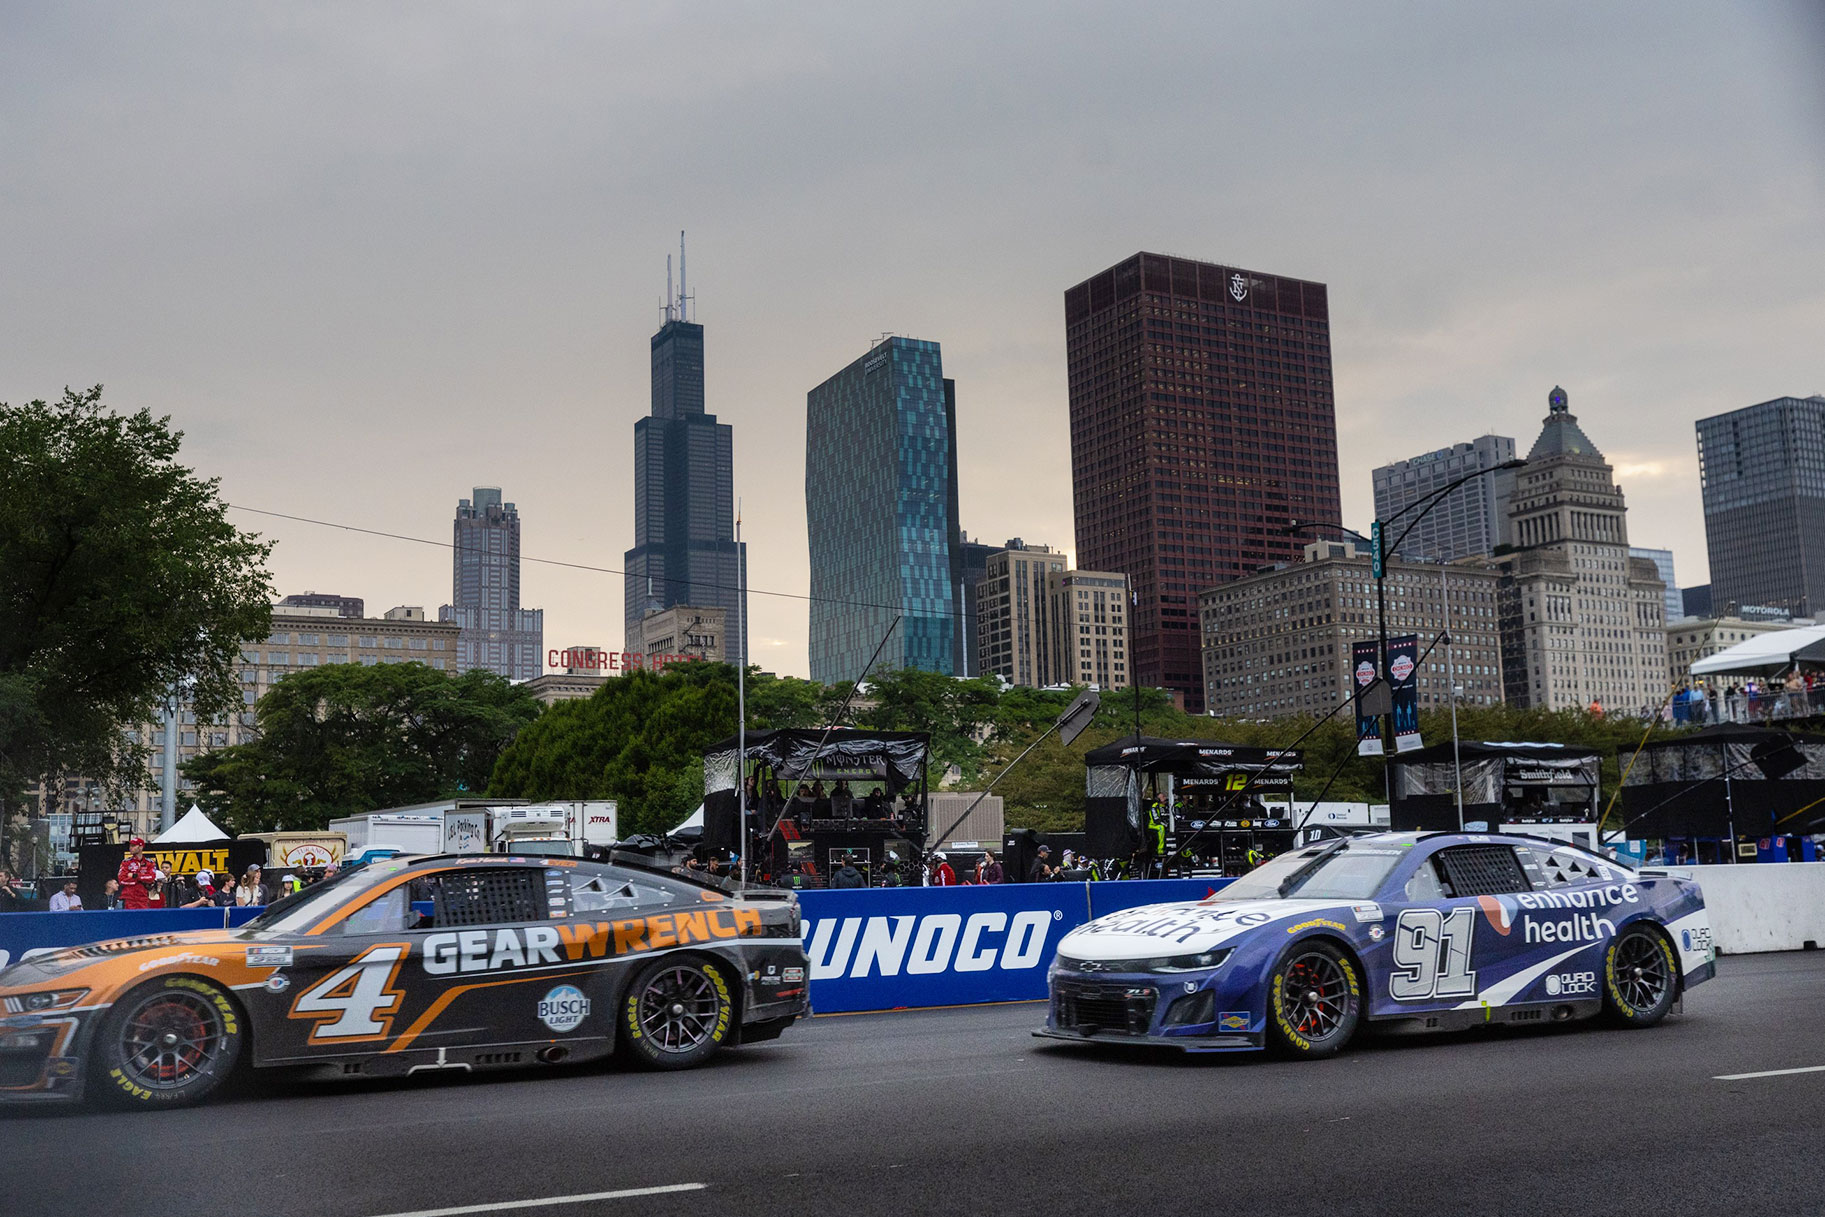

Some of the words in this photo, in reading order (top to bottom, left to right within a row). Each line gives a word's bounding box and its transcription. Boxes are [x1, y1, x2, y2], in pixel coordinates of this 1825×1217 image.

[1371, 527, 1381, 572] C540
[1742, 605, 1790, 616] MOTOROLA
[548, 649, 643, 671] CONGRESS
[826, 753, 885, 766] MONSTER
[1226, 774, 1247, 790] 12
[1520, 769, 1573, 783] Smithfield
[588, 816, 611, 824] XTRA
[1309, 830, 1321, 841] 10
[297, 846, 325, 856] TURANO
[1517, 884, 1639, 909] enhance
[1287, 918, 1346, 933] GOODYEAR
[1525, 913, 1616, 943] health
[422, 908, 762, 974] GEARWRENCH
[139, 952, 220, 971] GOODYEAR
[1390, 907, 1476, 1000] 91
[1660, 938, 1676, 973] EAGLE
[1338, 958, 1359, 996] EAGLE
[1561, 971, 1595, 983] QUAD
[289, 943, 408, 1044] 4
[1561, 982, 1595, 994] LOCK
[538, 998, 590, 1017] BUSCH
[702, 964, 732, 1041] GOODYEAR
[1273, 974, 1310, 1050] GOODYEAR
[550, 1014, 578, 1024] LIGHT
[627, 995, 642, 1039] EAGLE
[110, 1067, 152, 1100] EAGLE
